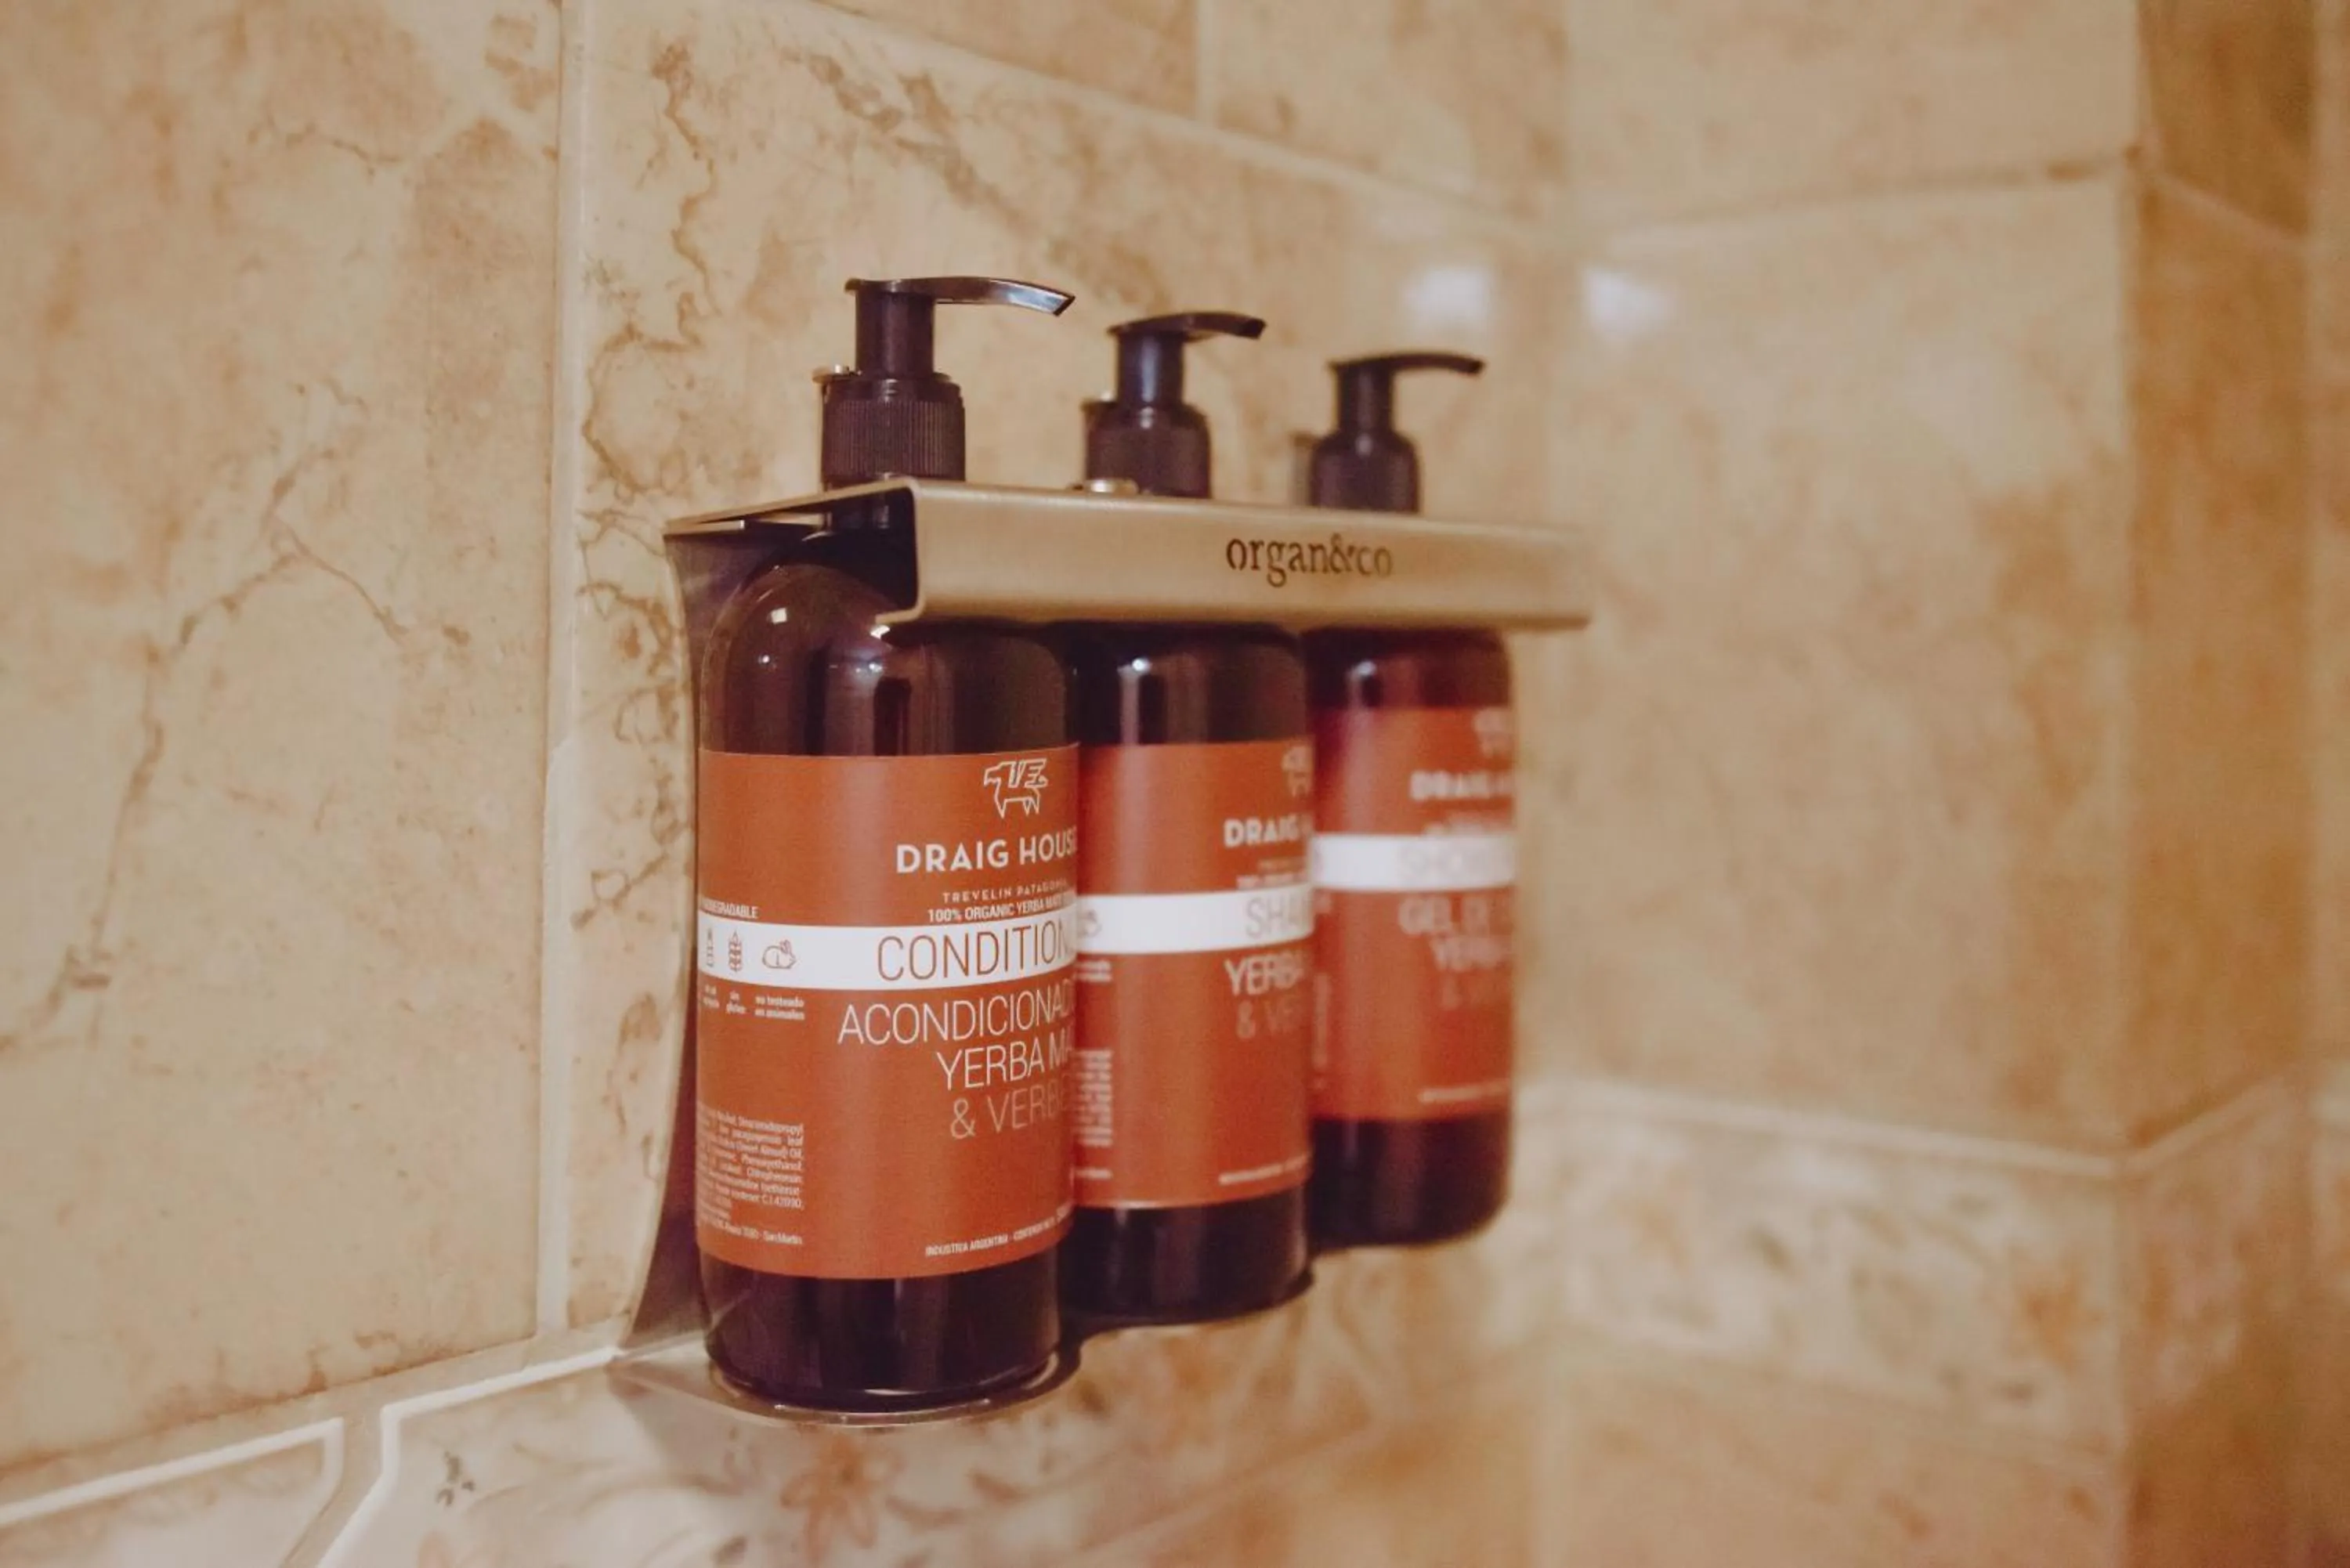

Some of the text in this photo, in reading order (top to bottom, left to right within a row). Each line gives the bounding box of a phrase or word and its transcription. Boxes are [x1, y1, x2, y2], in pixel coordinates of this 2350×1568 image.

[1226, 533, 1394, 587] organ&co
[896, 839, 1009, 873] DRAIG
[927, 907, 961, 923] 100%
[964, 901, 1014, 920] ORGANIC
[942, 888, 1011, 904] TREVELIN
[937, 1037, 1045, 1091] YERBA
[950, 1098, 976, 1140] &
